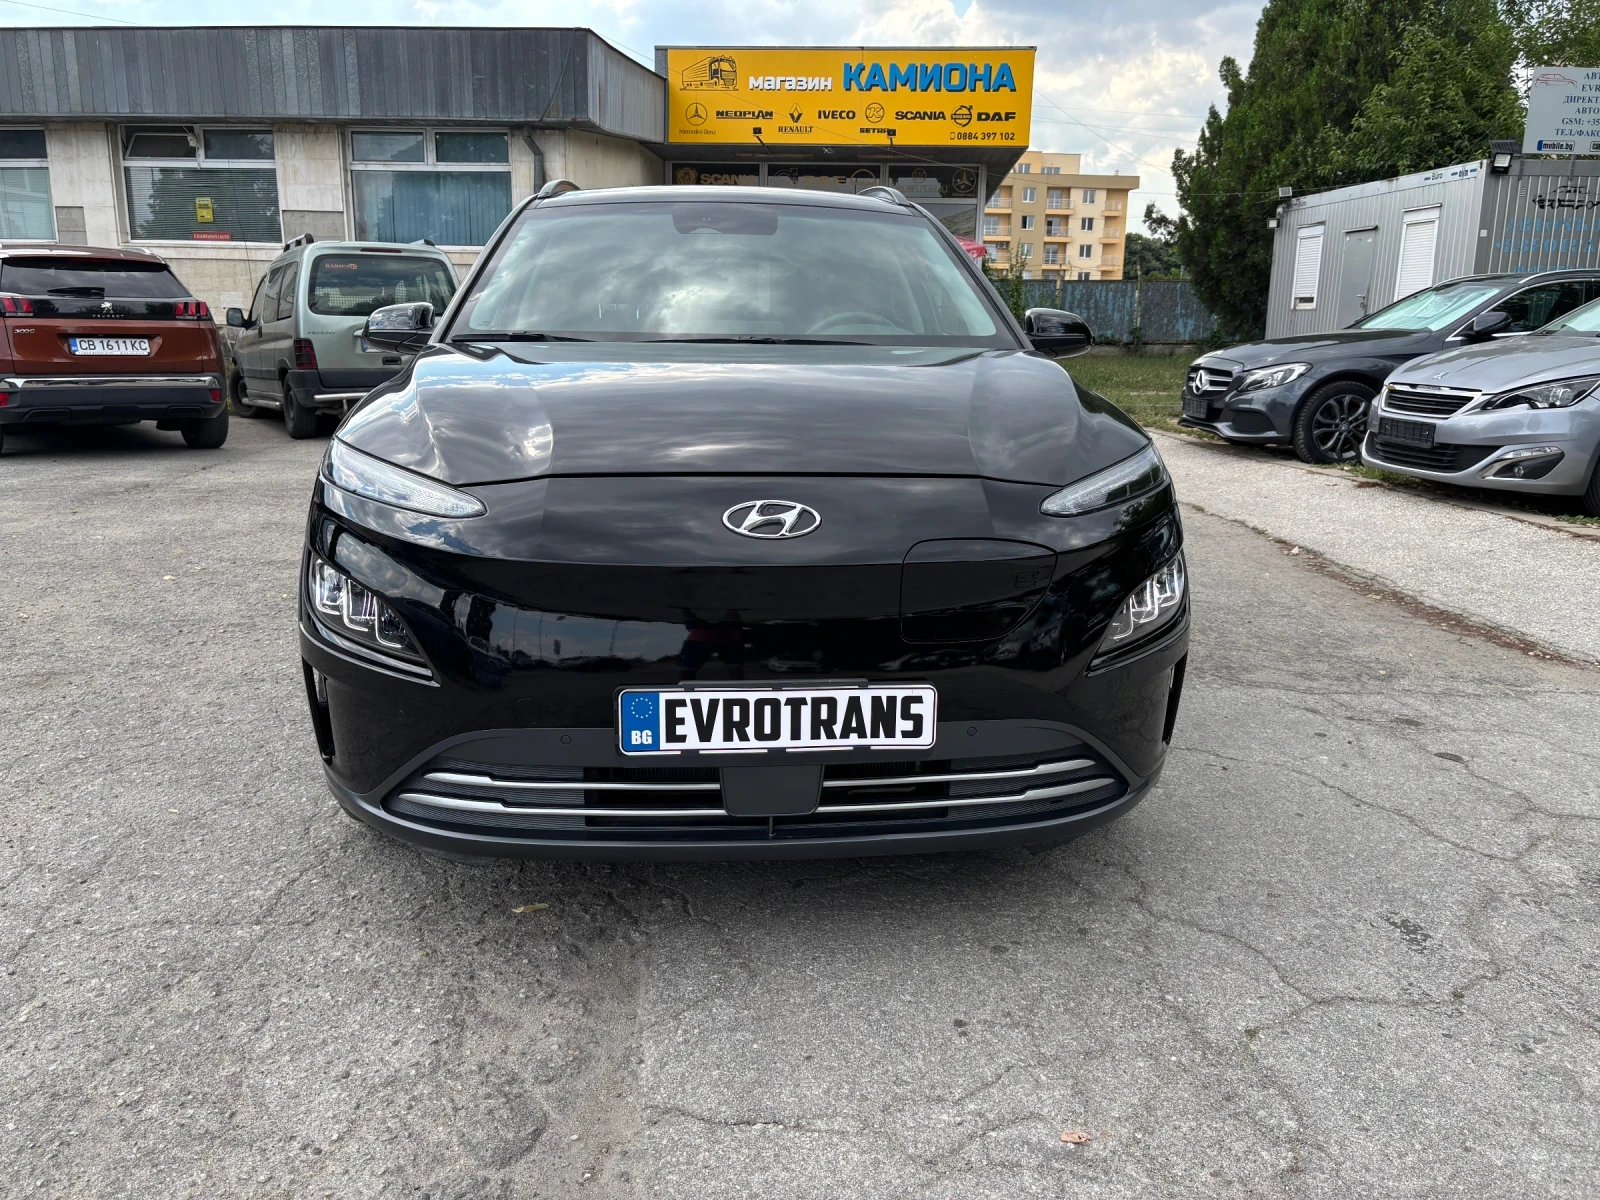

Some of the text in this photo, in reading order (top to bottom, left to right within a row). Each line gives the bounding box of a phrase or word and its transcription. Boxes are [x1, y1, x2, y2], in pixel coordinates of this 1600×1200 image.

[749, 62, 1016, 92] магазин КАМИОНА
[716, 110, 773, 119] NEOPLAN
[818, 110, 856, 120] IVECO
[1575, 106, 1600, 115] АВТО
[895, 111, 946, 121] SCANIA
[977, 112, 1016, 122] DAF
[957, 132, 1015, 141] 0884 397 102
[1543, 142, 1573, 151] mobile.bg
[79, 339, 97, 351] CB
[664, 695, 924, 744] EVROTRANS
[631, 730, 653, 745] BG
